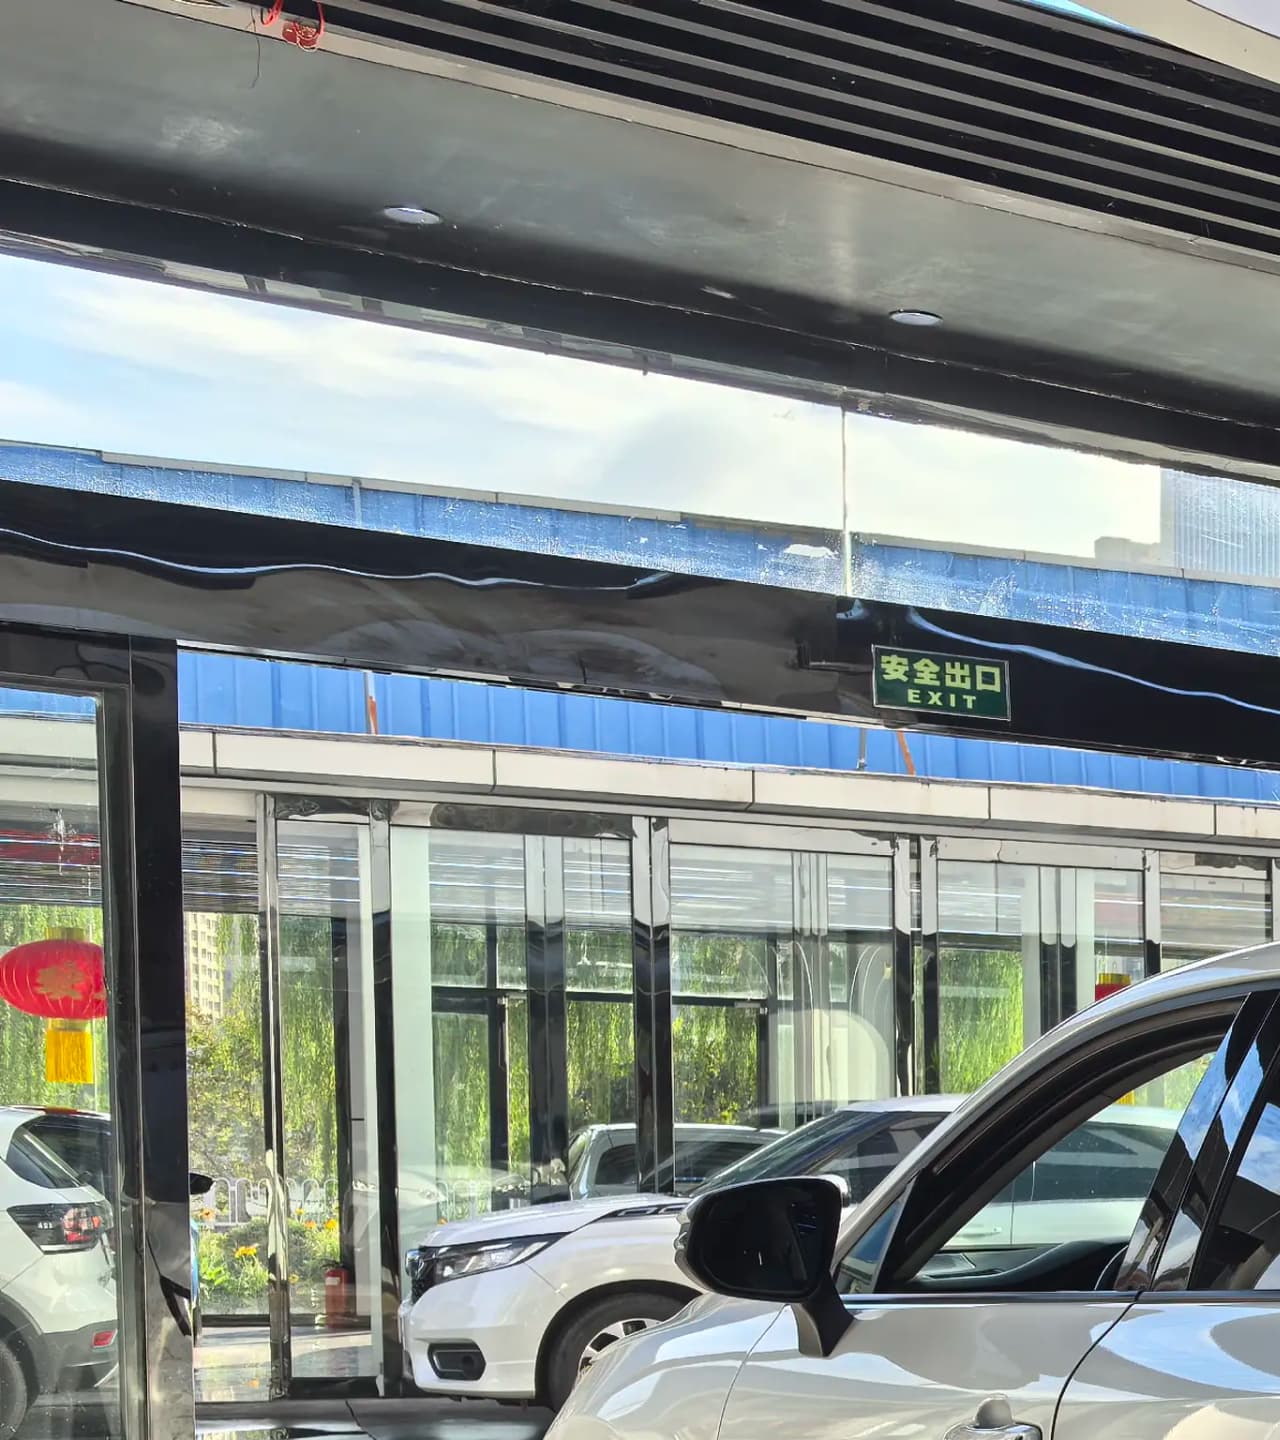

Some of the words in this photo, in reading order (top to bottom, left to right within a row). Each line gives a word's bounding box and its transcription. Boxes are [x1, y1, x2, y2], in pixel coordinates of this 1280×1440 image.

[881, 655, 1000, 692] 安全出口
[907, 689, 976, 709] EXIT
